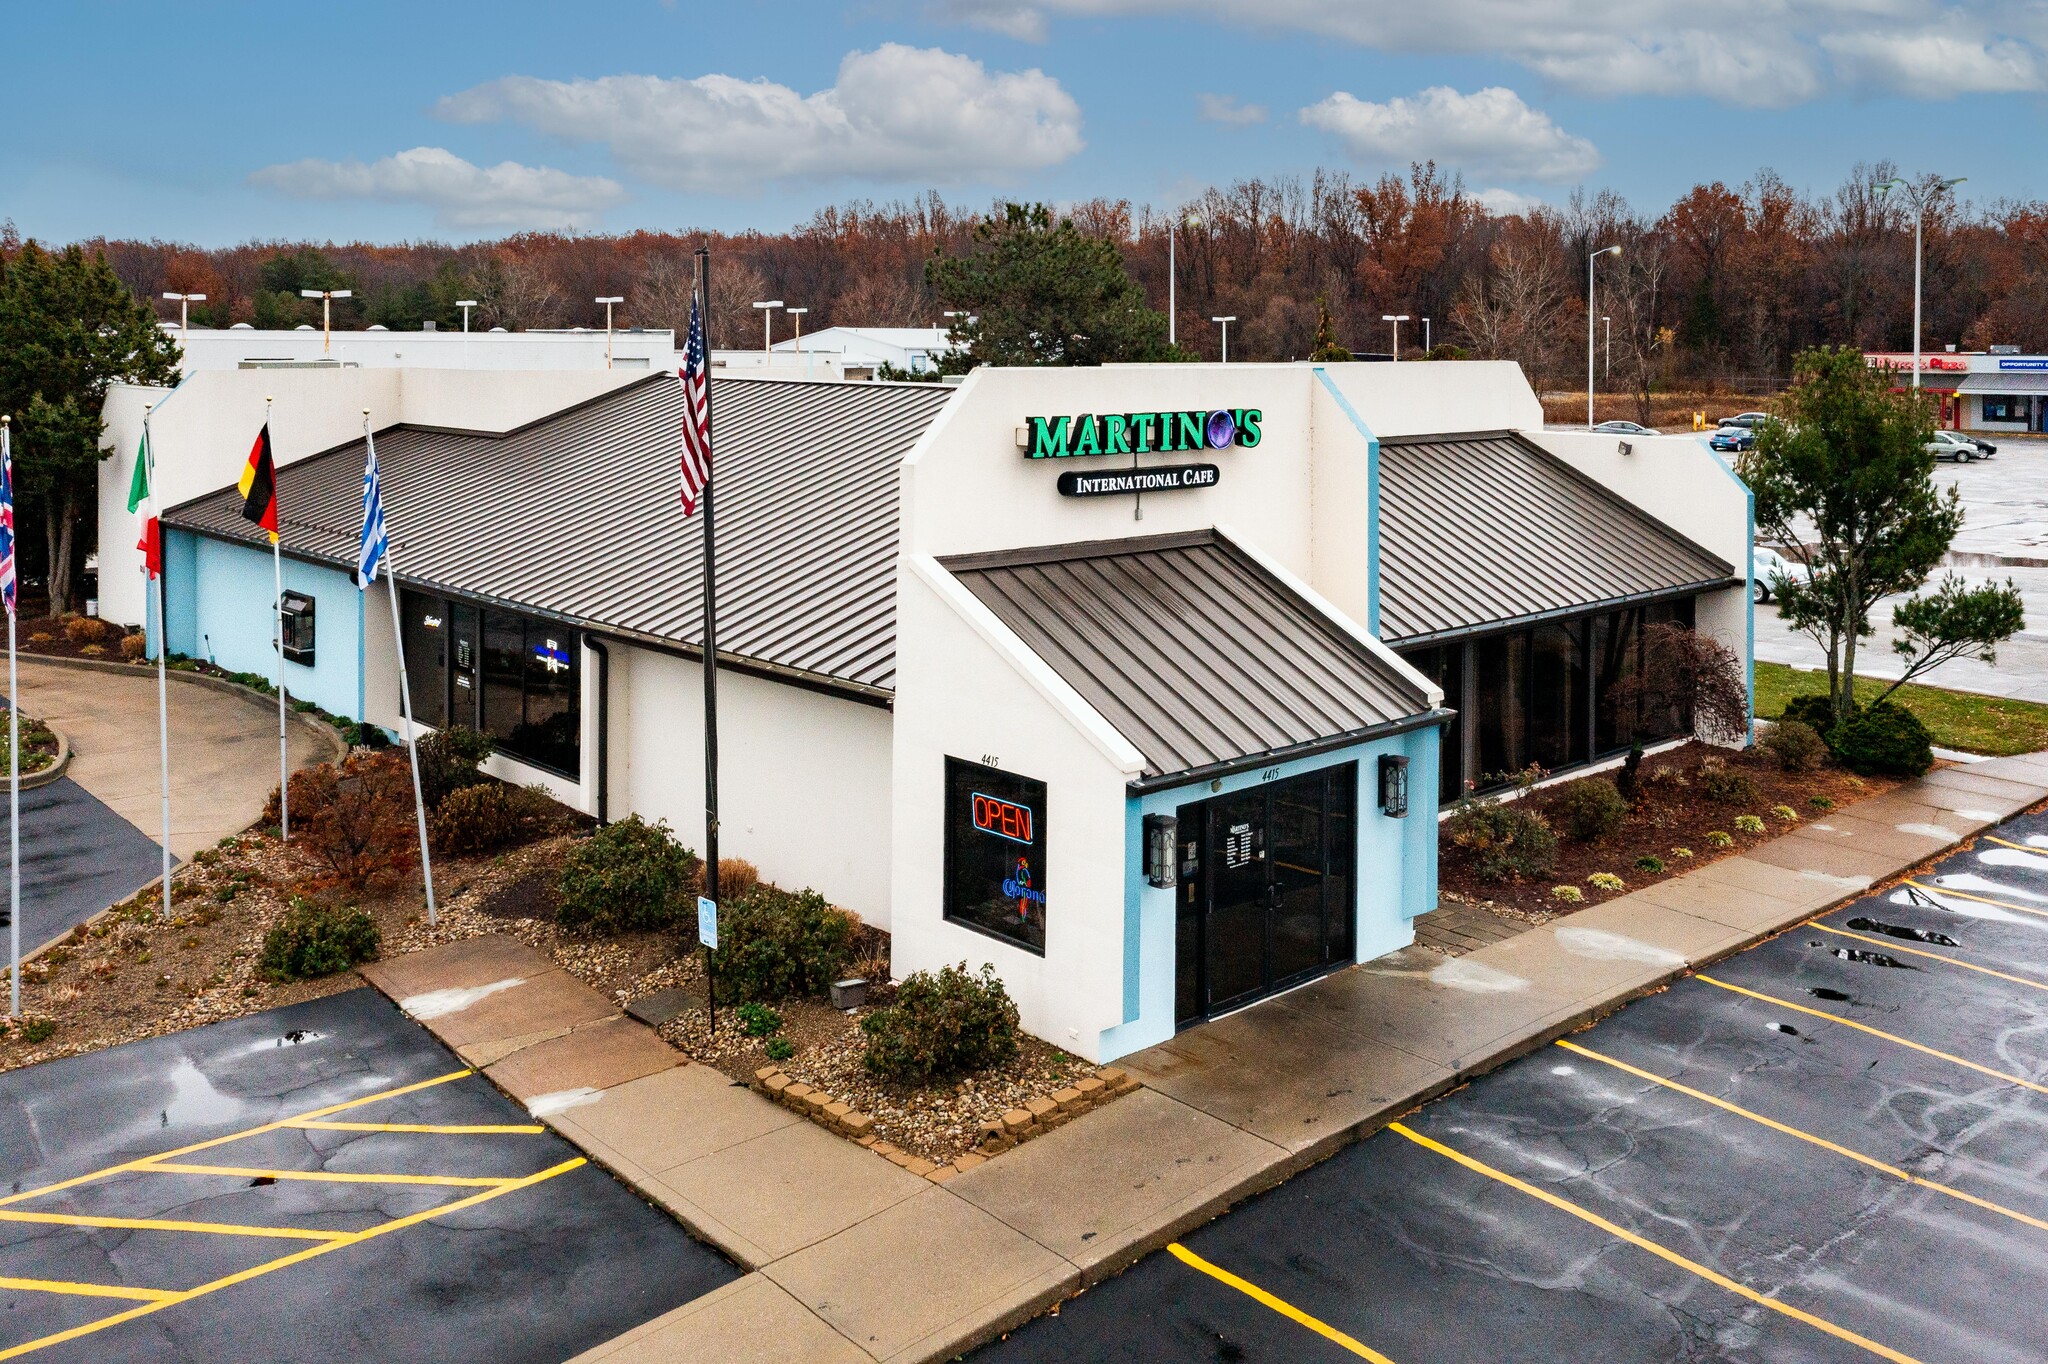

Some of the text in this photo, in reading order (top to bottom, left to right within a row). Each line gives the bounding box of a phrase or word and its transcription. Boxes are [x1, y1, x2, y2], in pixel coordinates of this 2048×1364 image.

[1929, 358, 1967, 370] Pizza
[1026, 409, 1262, 458] MARTINO'S
[1076, 469, 1214, 493] INTERNATIONAL CAFE
[981, 754, 1000, 768] 4415
[1262, 767, 1280, 782] 4415
[974, 797, 1031, 841] OPEN
